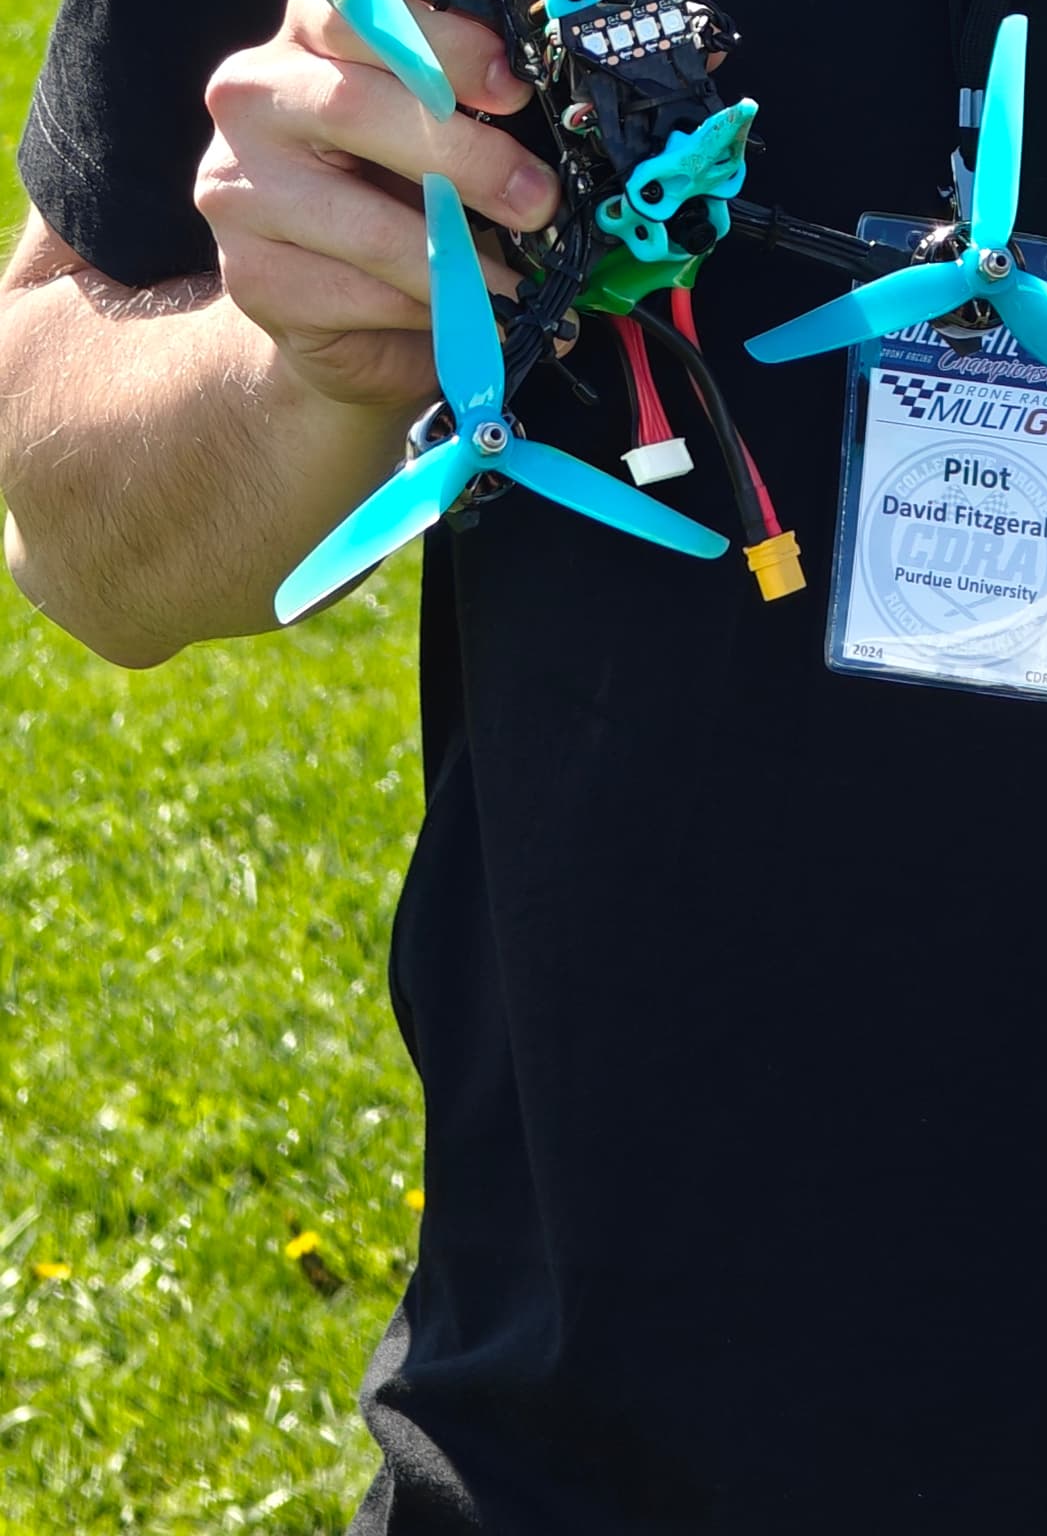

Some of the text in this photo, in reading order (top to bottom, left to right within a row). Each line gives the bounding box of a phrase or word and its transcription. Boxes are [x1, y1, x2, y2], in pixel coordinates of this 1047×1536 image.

[953, 384, 1012, 402] DRONE
[943, 457, 1012, 492] Pilot
[882, 494, 947, 523] David
[897, 522, 1044, 585] CDRA
[894, 566, 1038, 604] Purdue University
[852, 643, 883, 659] 2024
